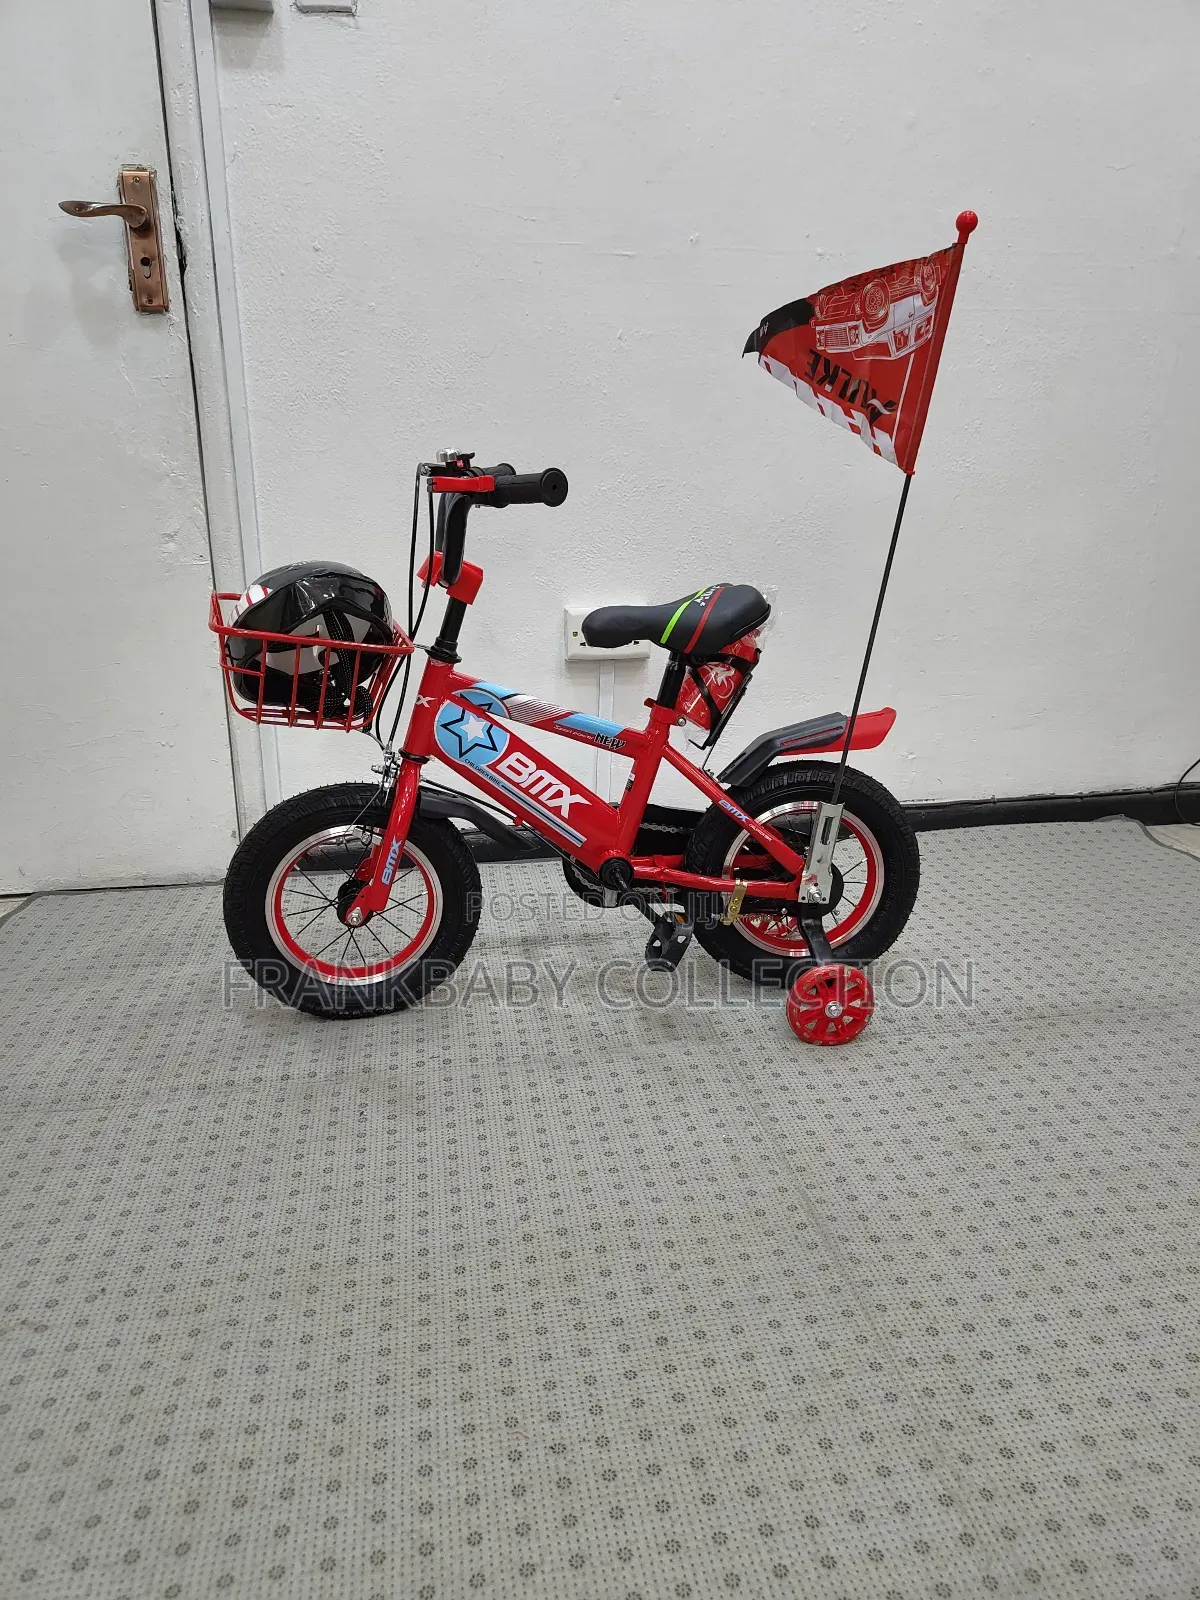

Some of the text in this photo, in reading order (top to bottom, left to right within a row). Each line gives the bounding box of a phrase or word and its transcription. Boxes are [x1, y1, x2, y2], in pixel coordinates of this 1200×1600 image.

[594, 731, 627, 750] NEW
[496, 751, 592, 819] BMX
[718, 798, 751, 823] BMX
[381, 834, 403, 886] BMX
